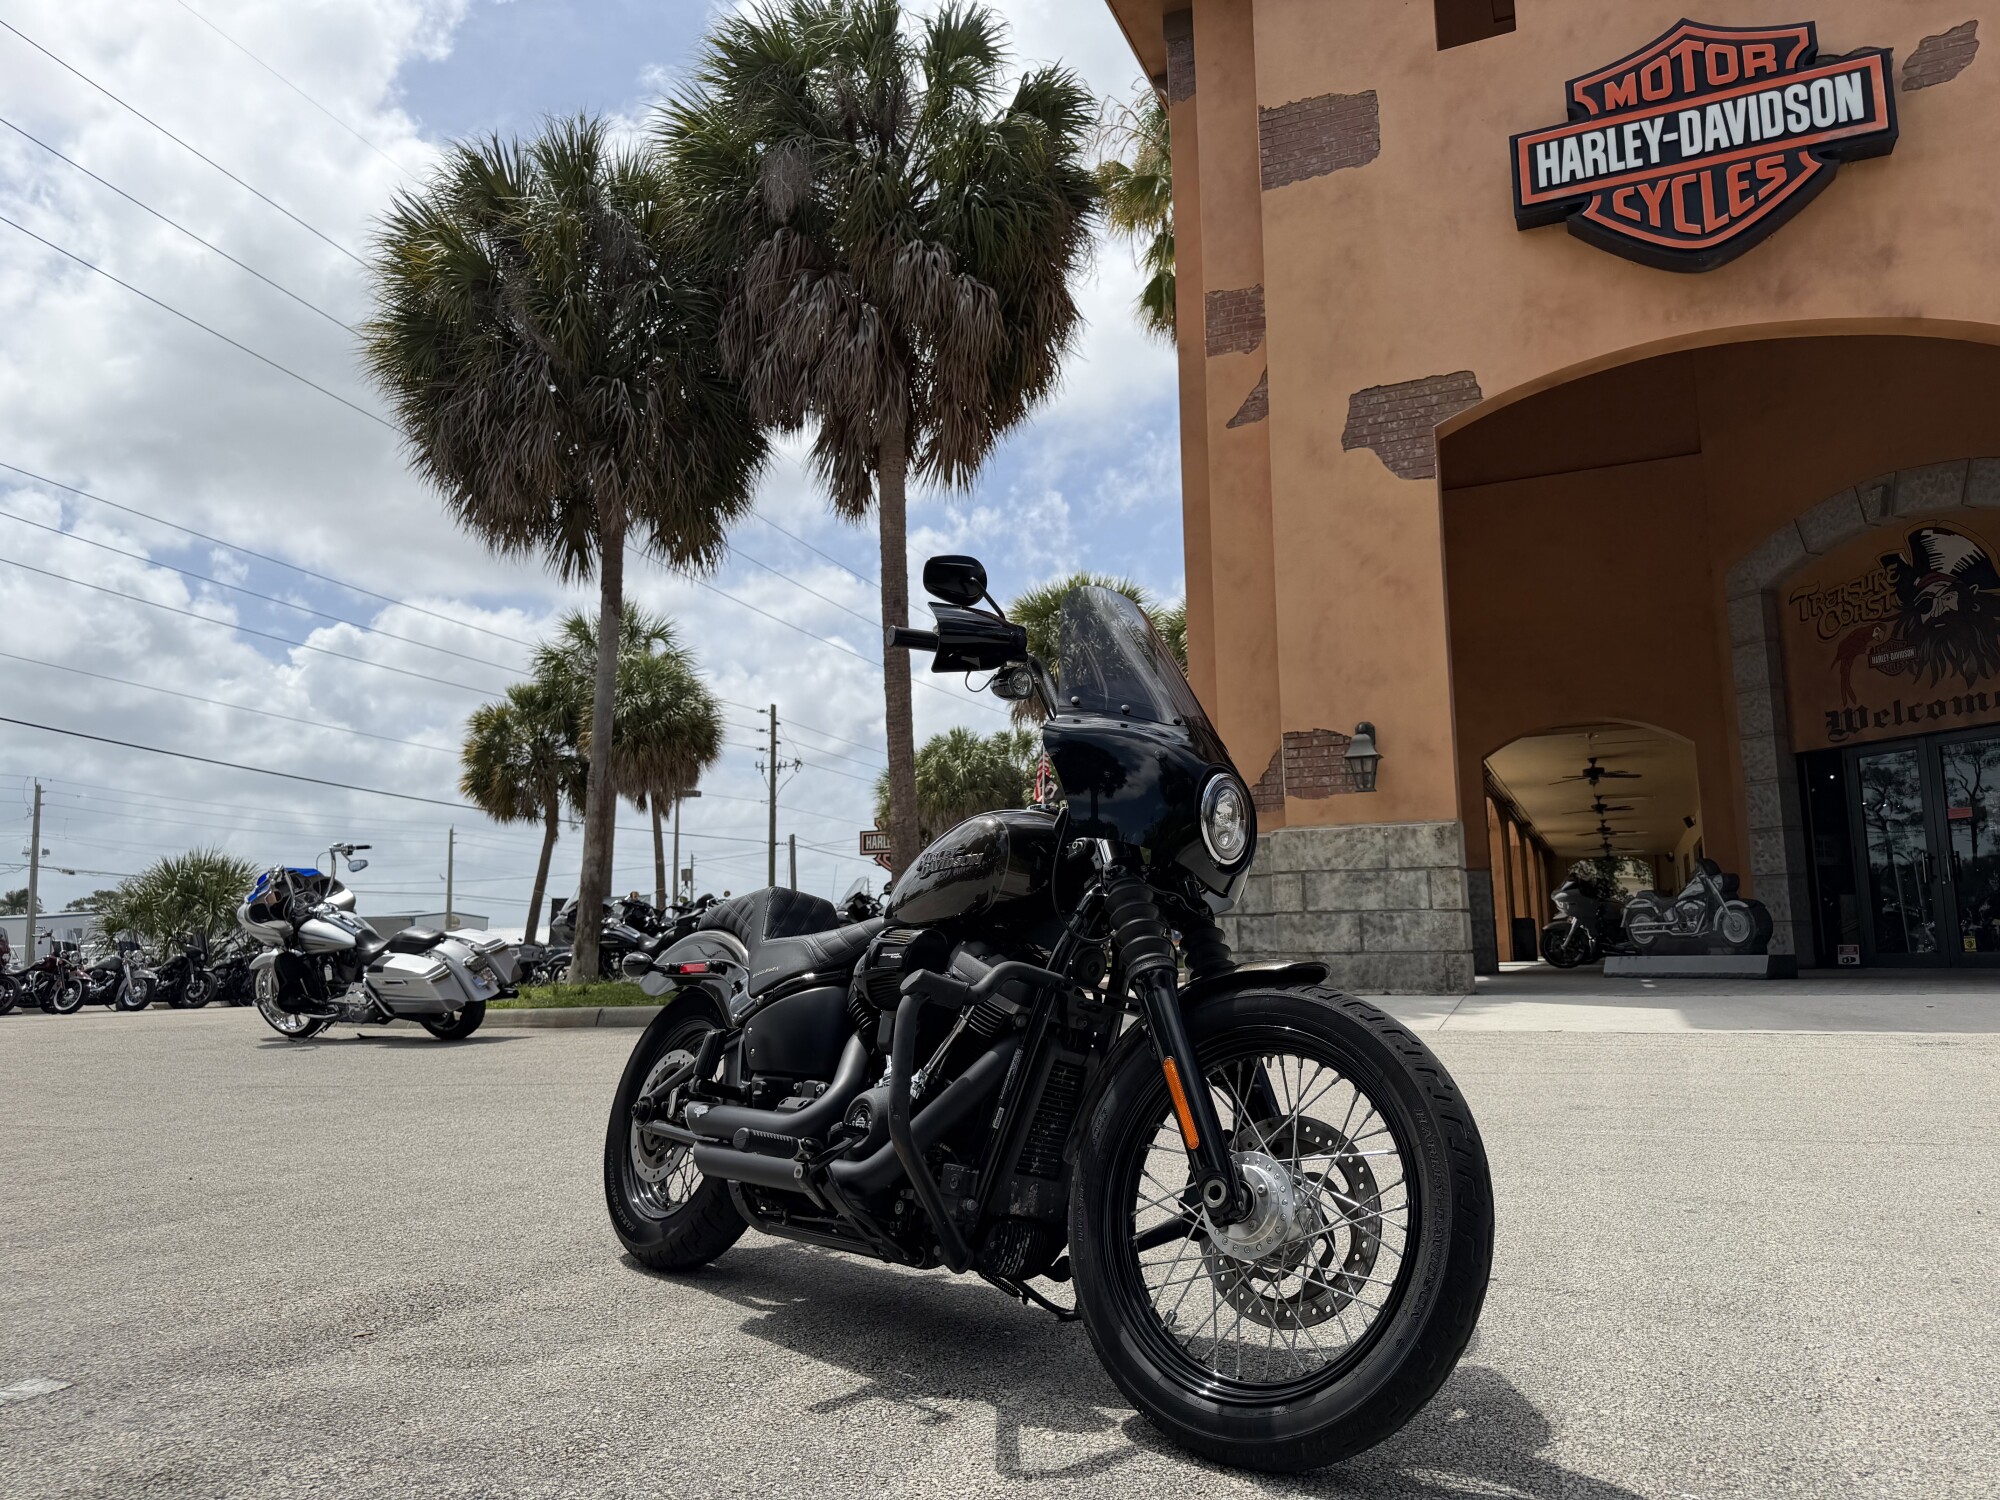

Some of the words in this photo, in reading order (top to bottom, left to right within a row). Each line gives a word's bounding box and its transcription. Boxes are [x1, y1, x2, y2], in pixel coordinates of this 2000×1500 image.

[1604, 39, 1779, 111] MOTOR
[1536, 72, 1865, 188] HARLEY-DAVIDSON
[1612, 153, 1788, 235] CYCLES
[1789, 562, 1900, 620] TREASURE
[1817, 586, 1897, 639] COAST
[1410, 1109, 1444, 1325] HARLEY-DAVIDSON
